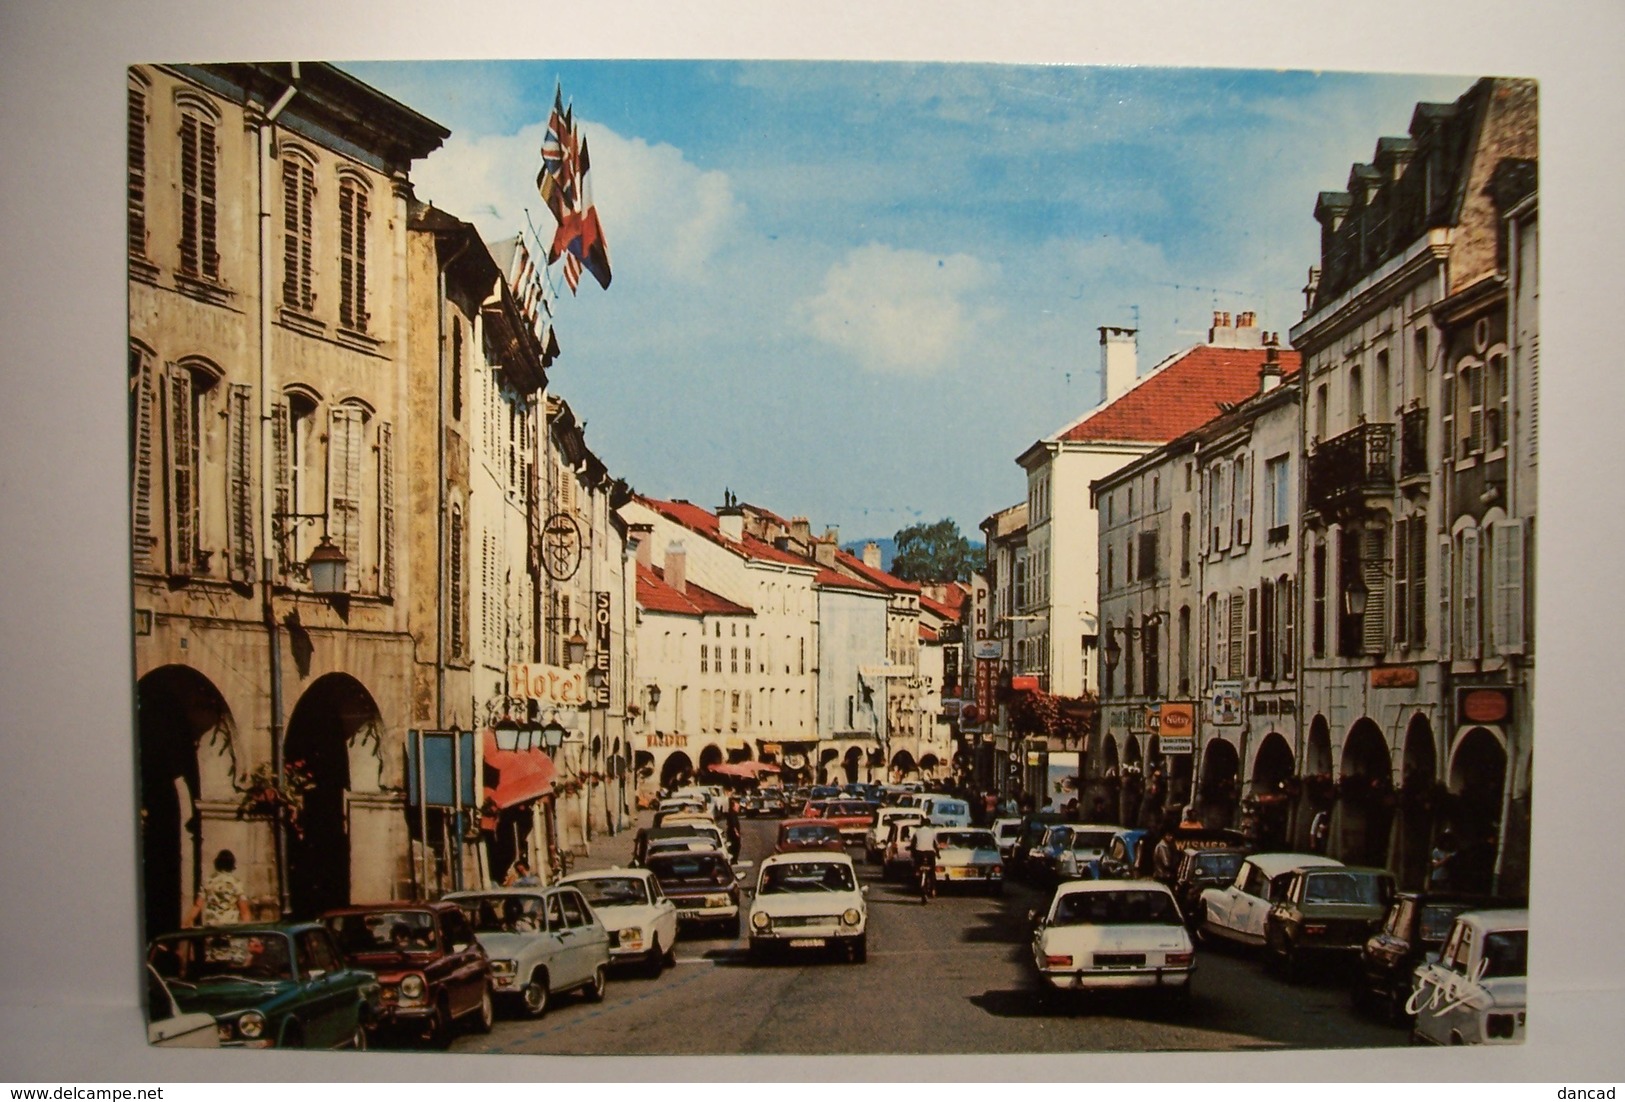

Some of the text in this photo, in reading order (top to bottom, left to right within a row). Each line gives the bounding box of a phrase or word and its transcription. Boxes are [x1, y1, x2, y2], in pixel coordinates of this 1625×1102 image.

[511, 663, 585, 703] Hotel
[978, 661, 986, 716] ARTHUR
[989, 661, 998, 716] MARTIN
